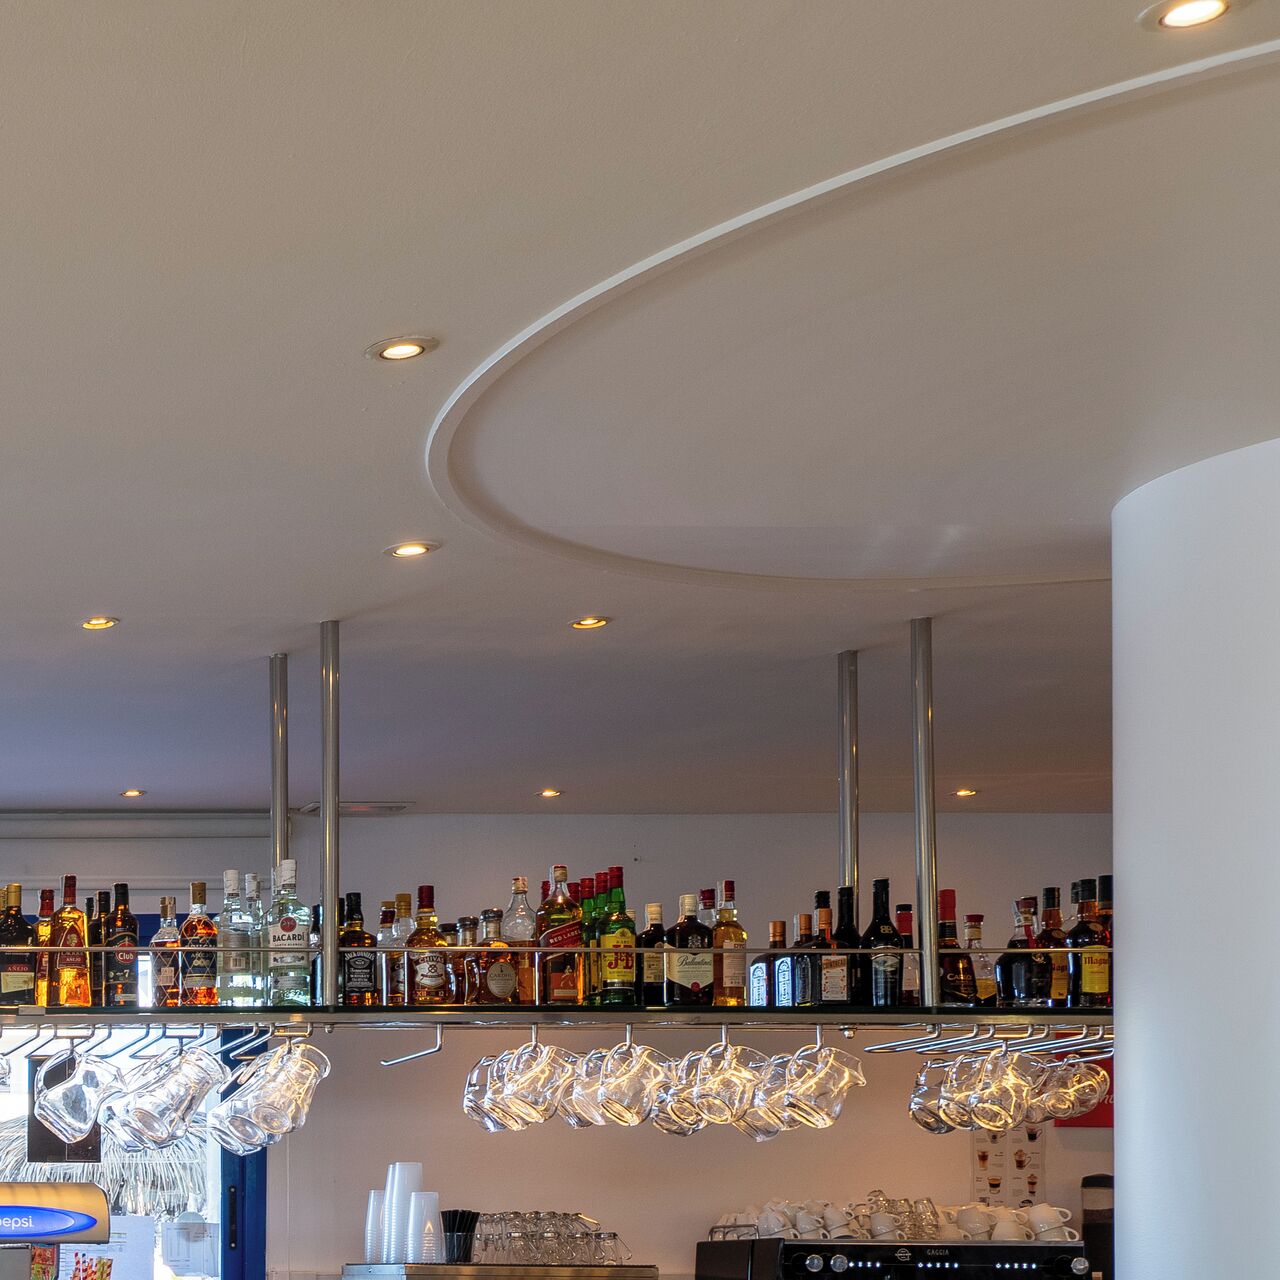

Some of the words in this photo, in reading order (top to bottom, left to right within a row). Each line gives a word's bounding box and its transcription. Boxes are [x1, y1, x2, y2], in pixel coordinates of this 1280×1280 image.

[272, 932, 306, 943] BACARDÍ
[549, 934, 563, 944] RED
[119, 952, 134, 960] Club
[123, 969, 130, 978] 7
[926, 1248, 950, 1256] GAGGIA
